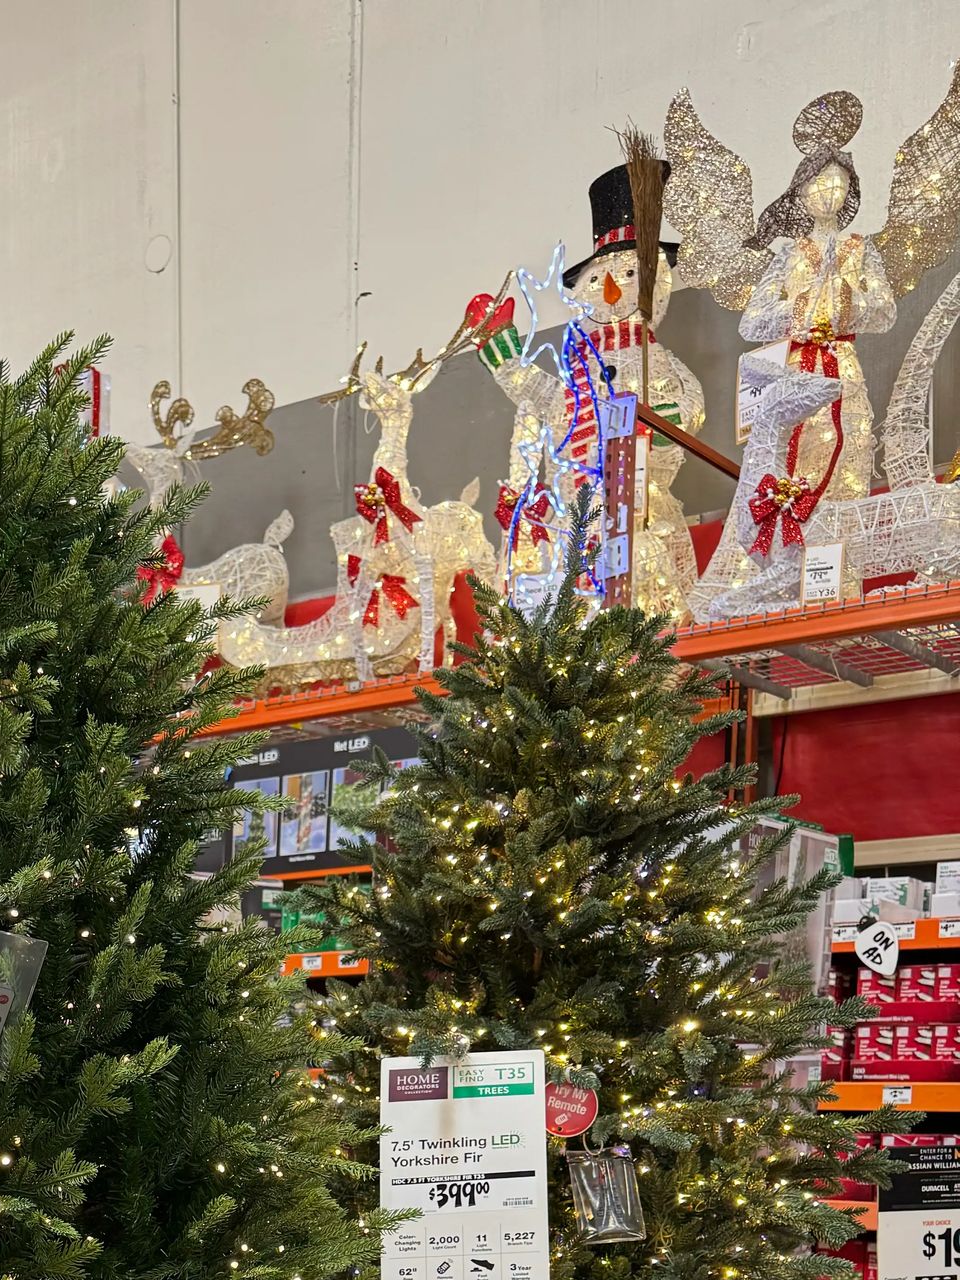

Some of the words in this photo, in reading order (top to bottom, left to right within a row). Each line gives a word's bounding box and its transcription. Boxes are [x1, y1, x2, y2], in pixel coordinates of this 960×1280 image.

[818, 588, 836, 597] Y36
[348, 738, 368, 751] LED
[259, 751, 278, 763] LED
[873, 931, 894, 951] ON
[862, 947, 883, 965] AD
[397, 1073, 440, 1085] HOME
[459, 1069, 485, 1077] EASY
[495, 1067, 526, 1080] T35
[478, 1086, 510, 1095] TREES
[572, 1088, 589, 1102] My
[548, 1096, 587, 1115] Remote
[391, 1140, 414, 1152] 7.5'
[419, 1137, 487, 1151] Twinkling
[491, 1134, 520, 1147] LED
[391, 1154, 459, 1168] Yorkshire
[464, 1152, 483, 1164] Fir
[427, 1175, 461, 1183] YORKSHIRE
[429, 1236, 460, 1246] 2,000
[476, 1234, 487, 1242] 11
[504, 1232, 535, 1242] 5,227
[510, 1263, 517, 1271] 3
